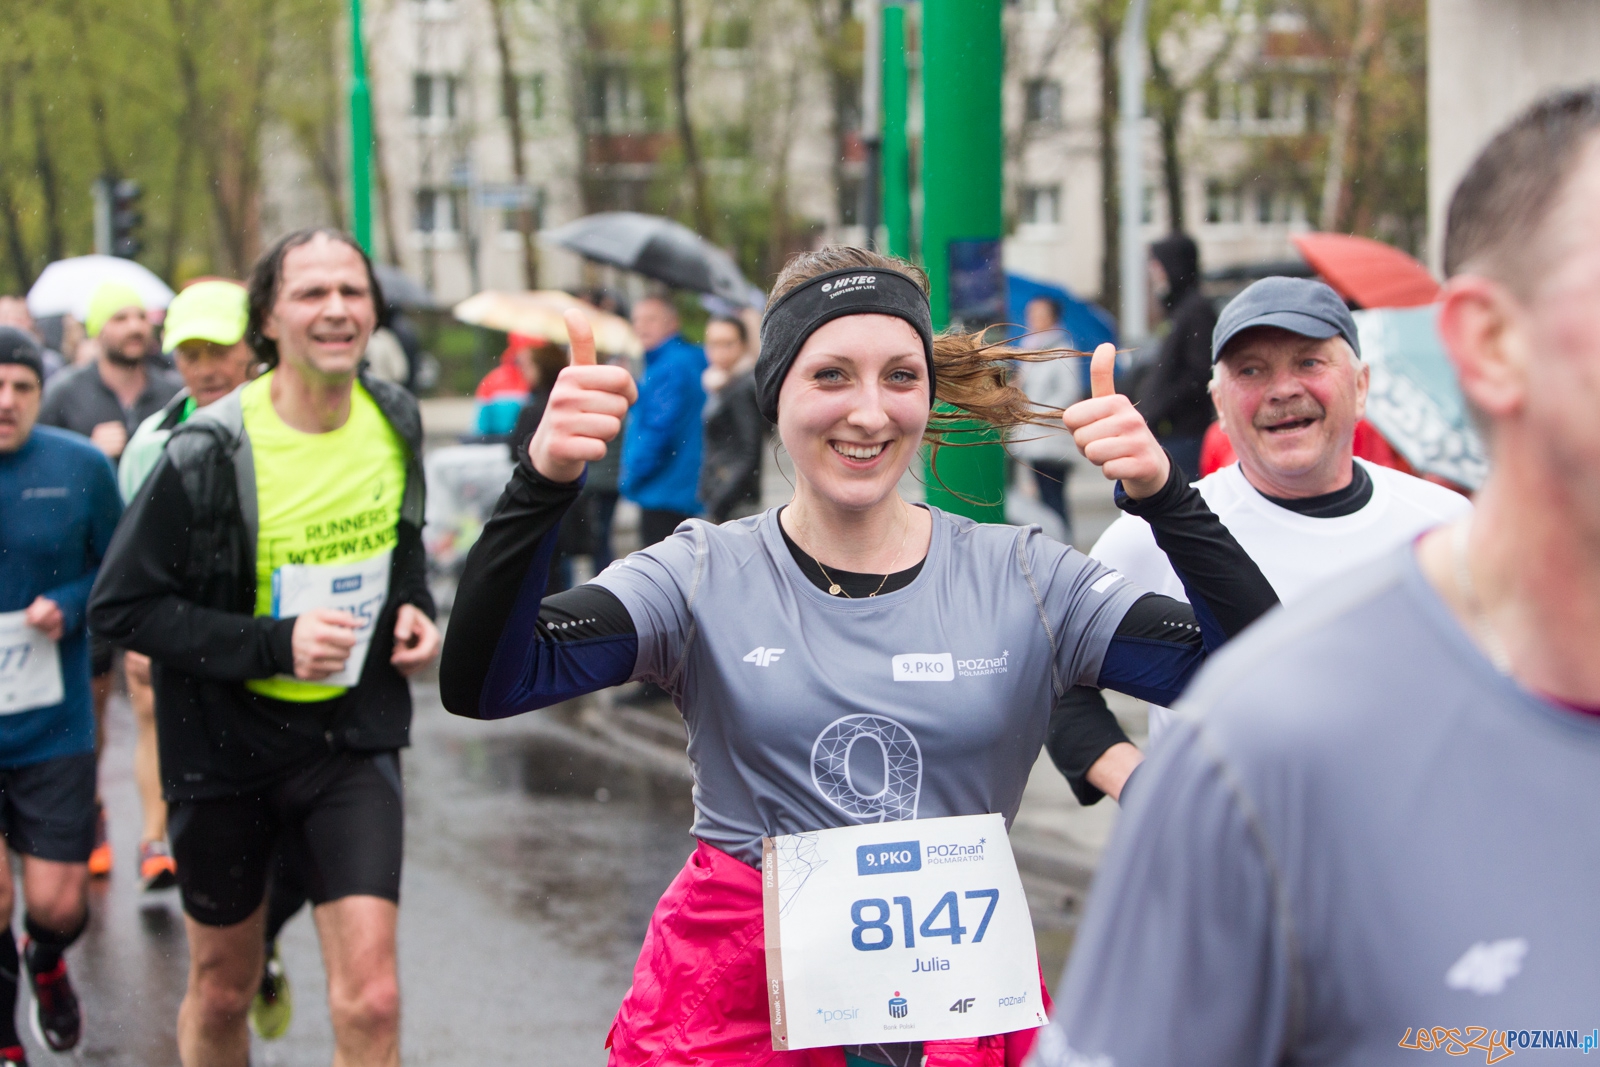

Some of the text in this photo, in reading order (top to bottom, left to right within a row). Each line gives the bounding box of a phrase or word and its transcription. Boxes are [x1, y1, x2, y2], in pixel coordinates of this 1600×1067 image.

[833, 275, 876, 289] HI-TEC
[305, 507, 387, 542] RUNNERS
[742, 646, 786, 667] 4F
[958, 667, 1008, 677] PÓŁMARATON
[927, 855, 984, 865] PÓŁMARATON
[851, 888, 1000, 951] 8147
[912, 957, 951, 973] Julia
[949, 998, 976, 1014] 4F
